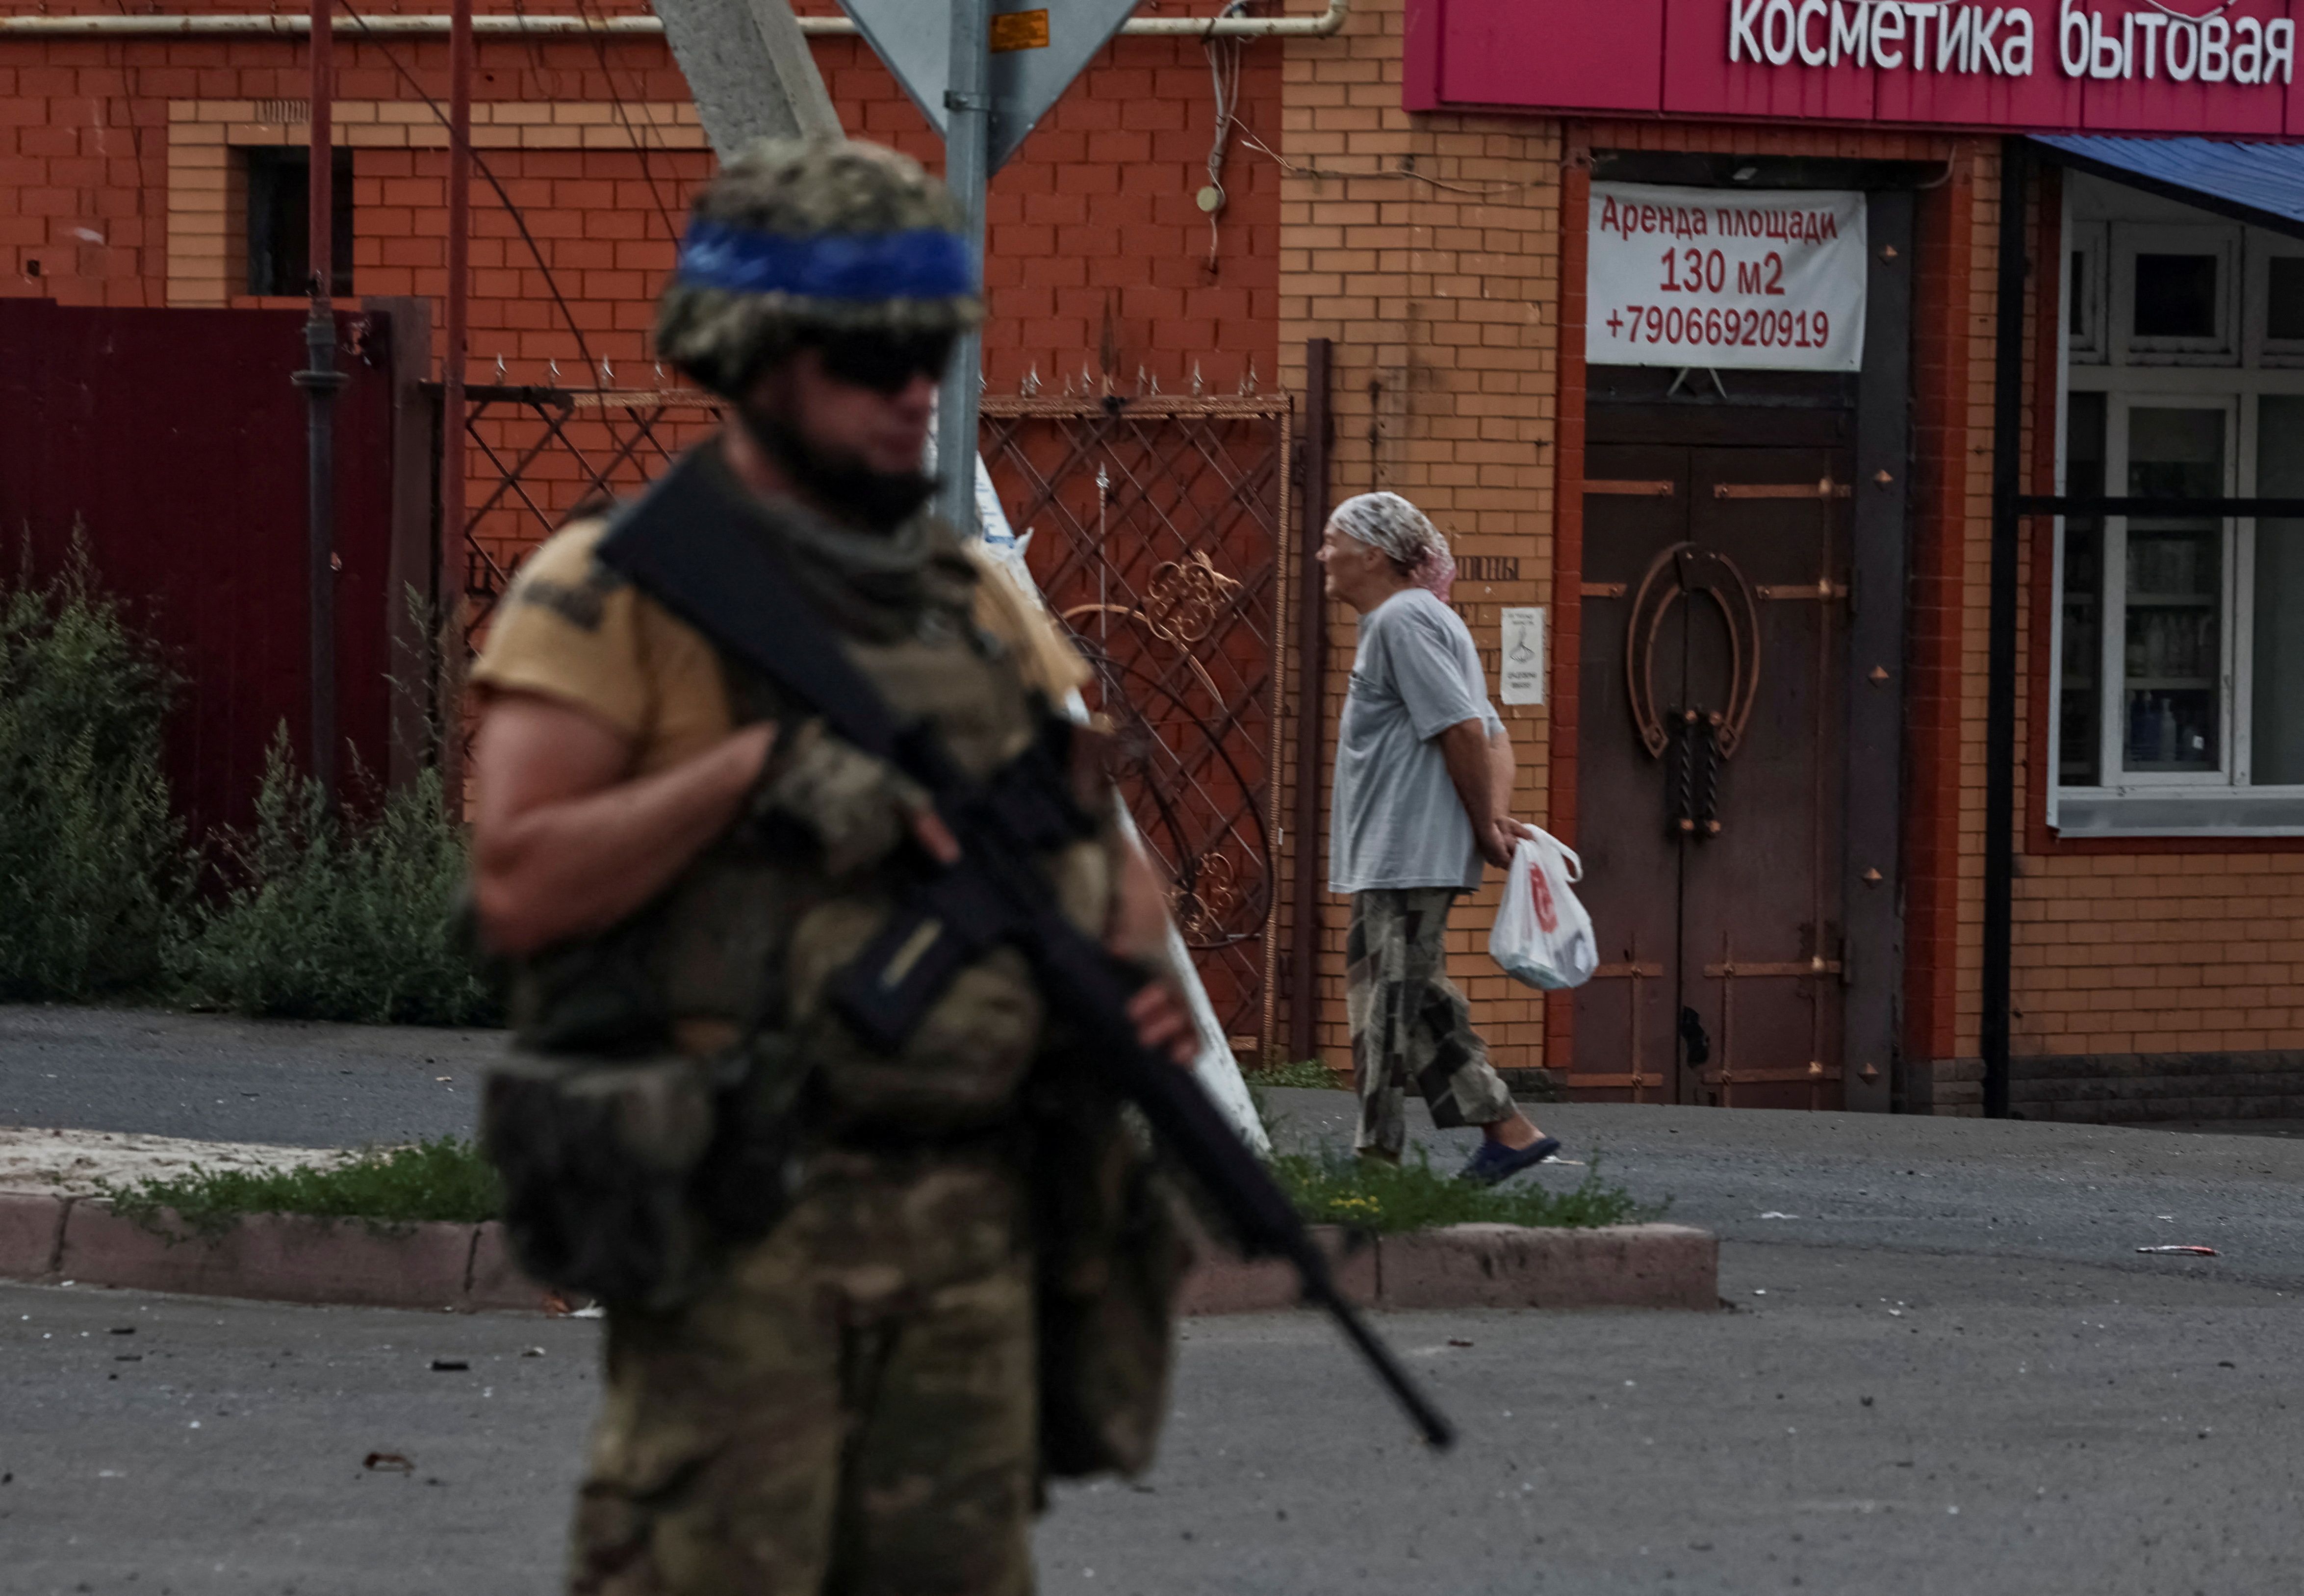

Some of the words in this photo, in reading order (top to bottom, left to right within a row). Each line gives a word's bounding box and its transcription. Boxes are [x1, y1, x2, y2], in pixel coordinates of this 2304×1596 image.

[2060, 0, 2295, 84] бытовая
[1601, 194, 1708, 241] Аренда
[1716, 208, 1839, 245] площади
[1660, 246, 1726, 293] 130
[1738, 251, 1785, 295] м2
[1606, 305, 1829, 348] +79066920919
